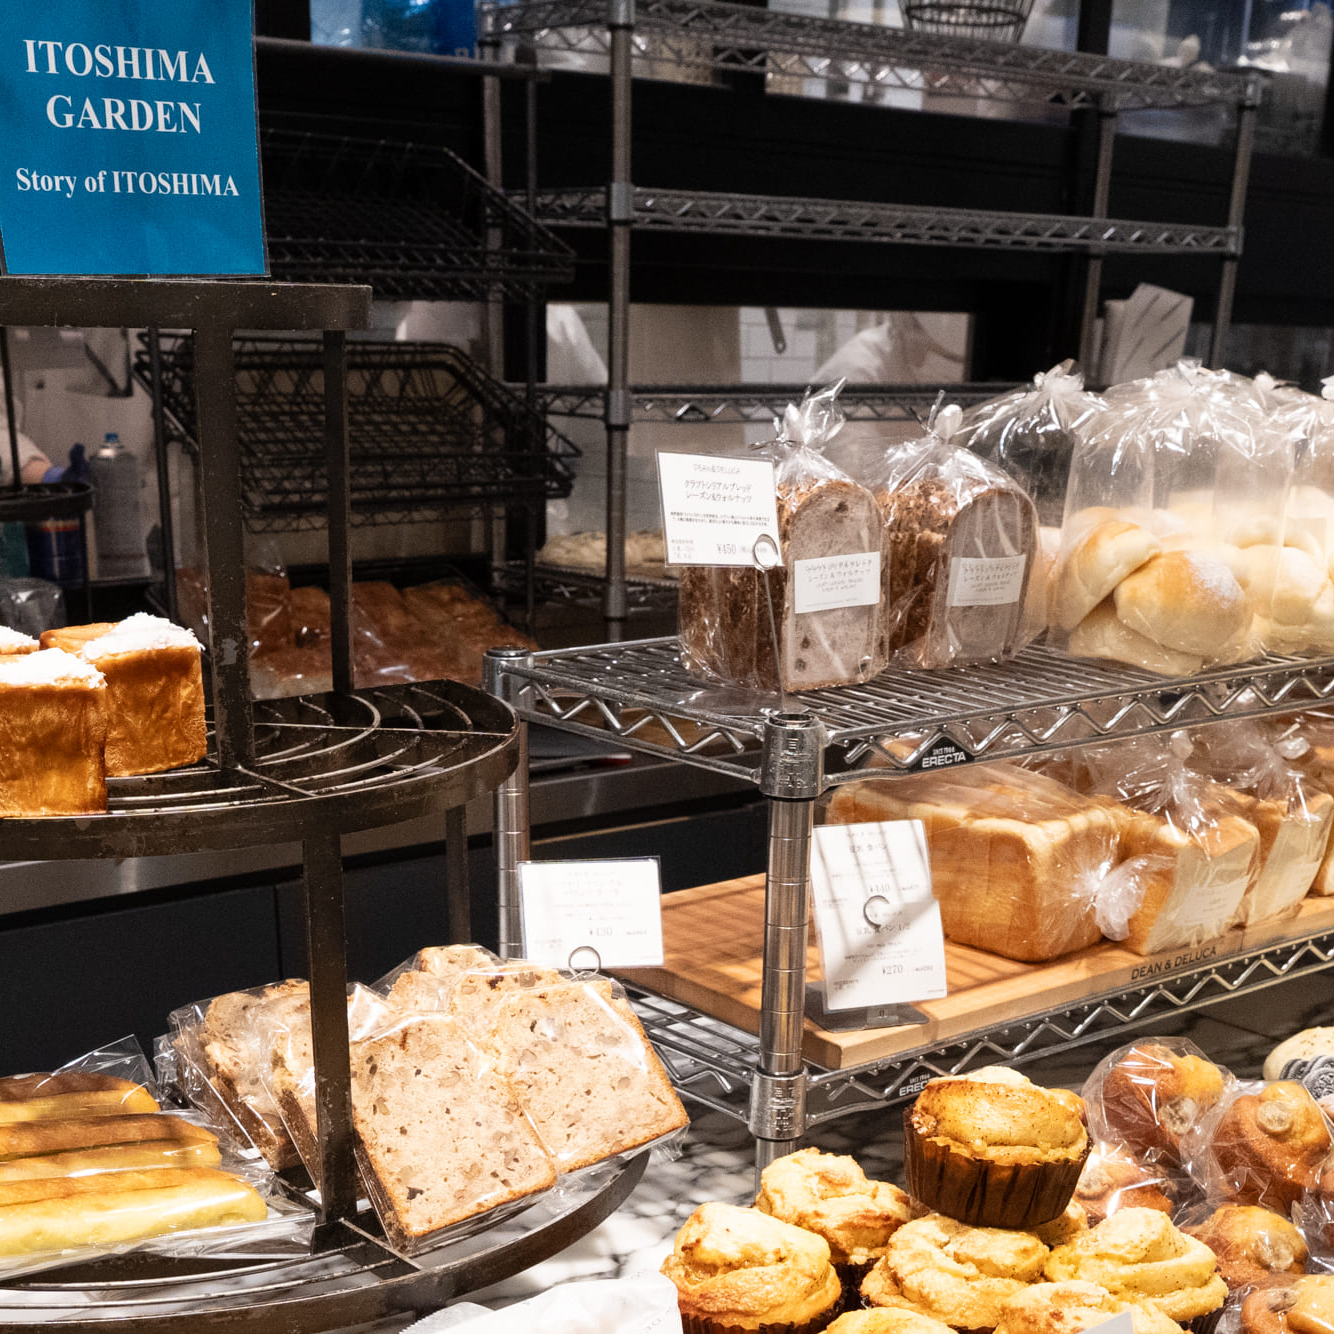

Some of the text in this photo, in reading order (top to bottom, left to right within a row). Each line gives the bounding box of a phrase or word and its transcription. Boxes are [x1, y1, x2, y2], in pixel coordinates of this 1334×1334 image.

[23, 40, 216, 84] ITOSHIMA
[46, 94, 201, 134] GARDEN
[16, 168, 239, 198] Story of ITOSHIMA
[717, 543, 736, 554] ¥450
[922, 752, 967, 768] ERECTA
[882, 964, 904, 975] ¥270
[1131, 946, 1217, 980] DEAN & DELUCA
